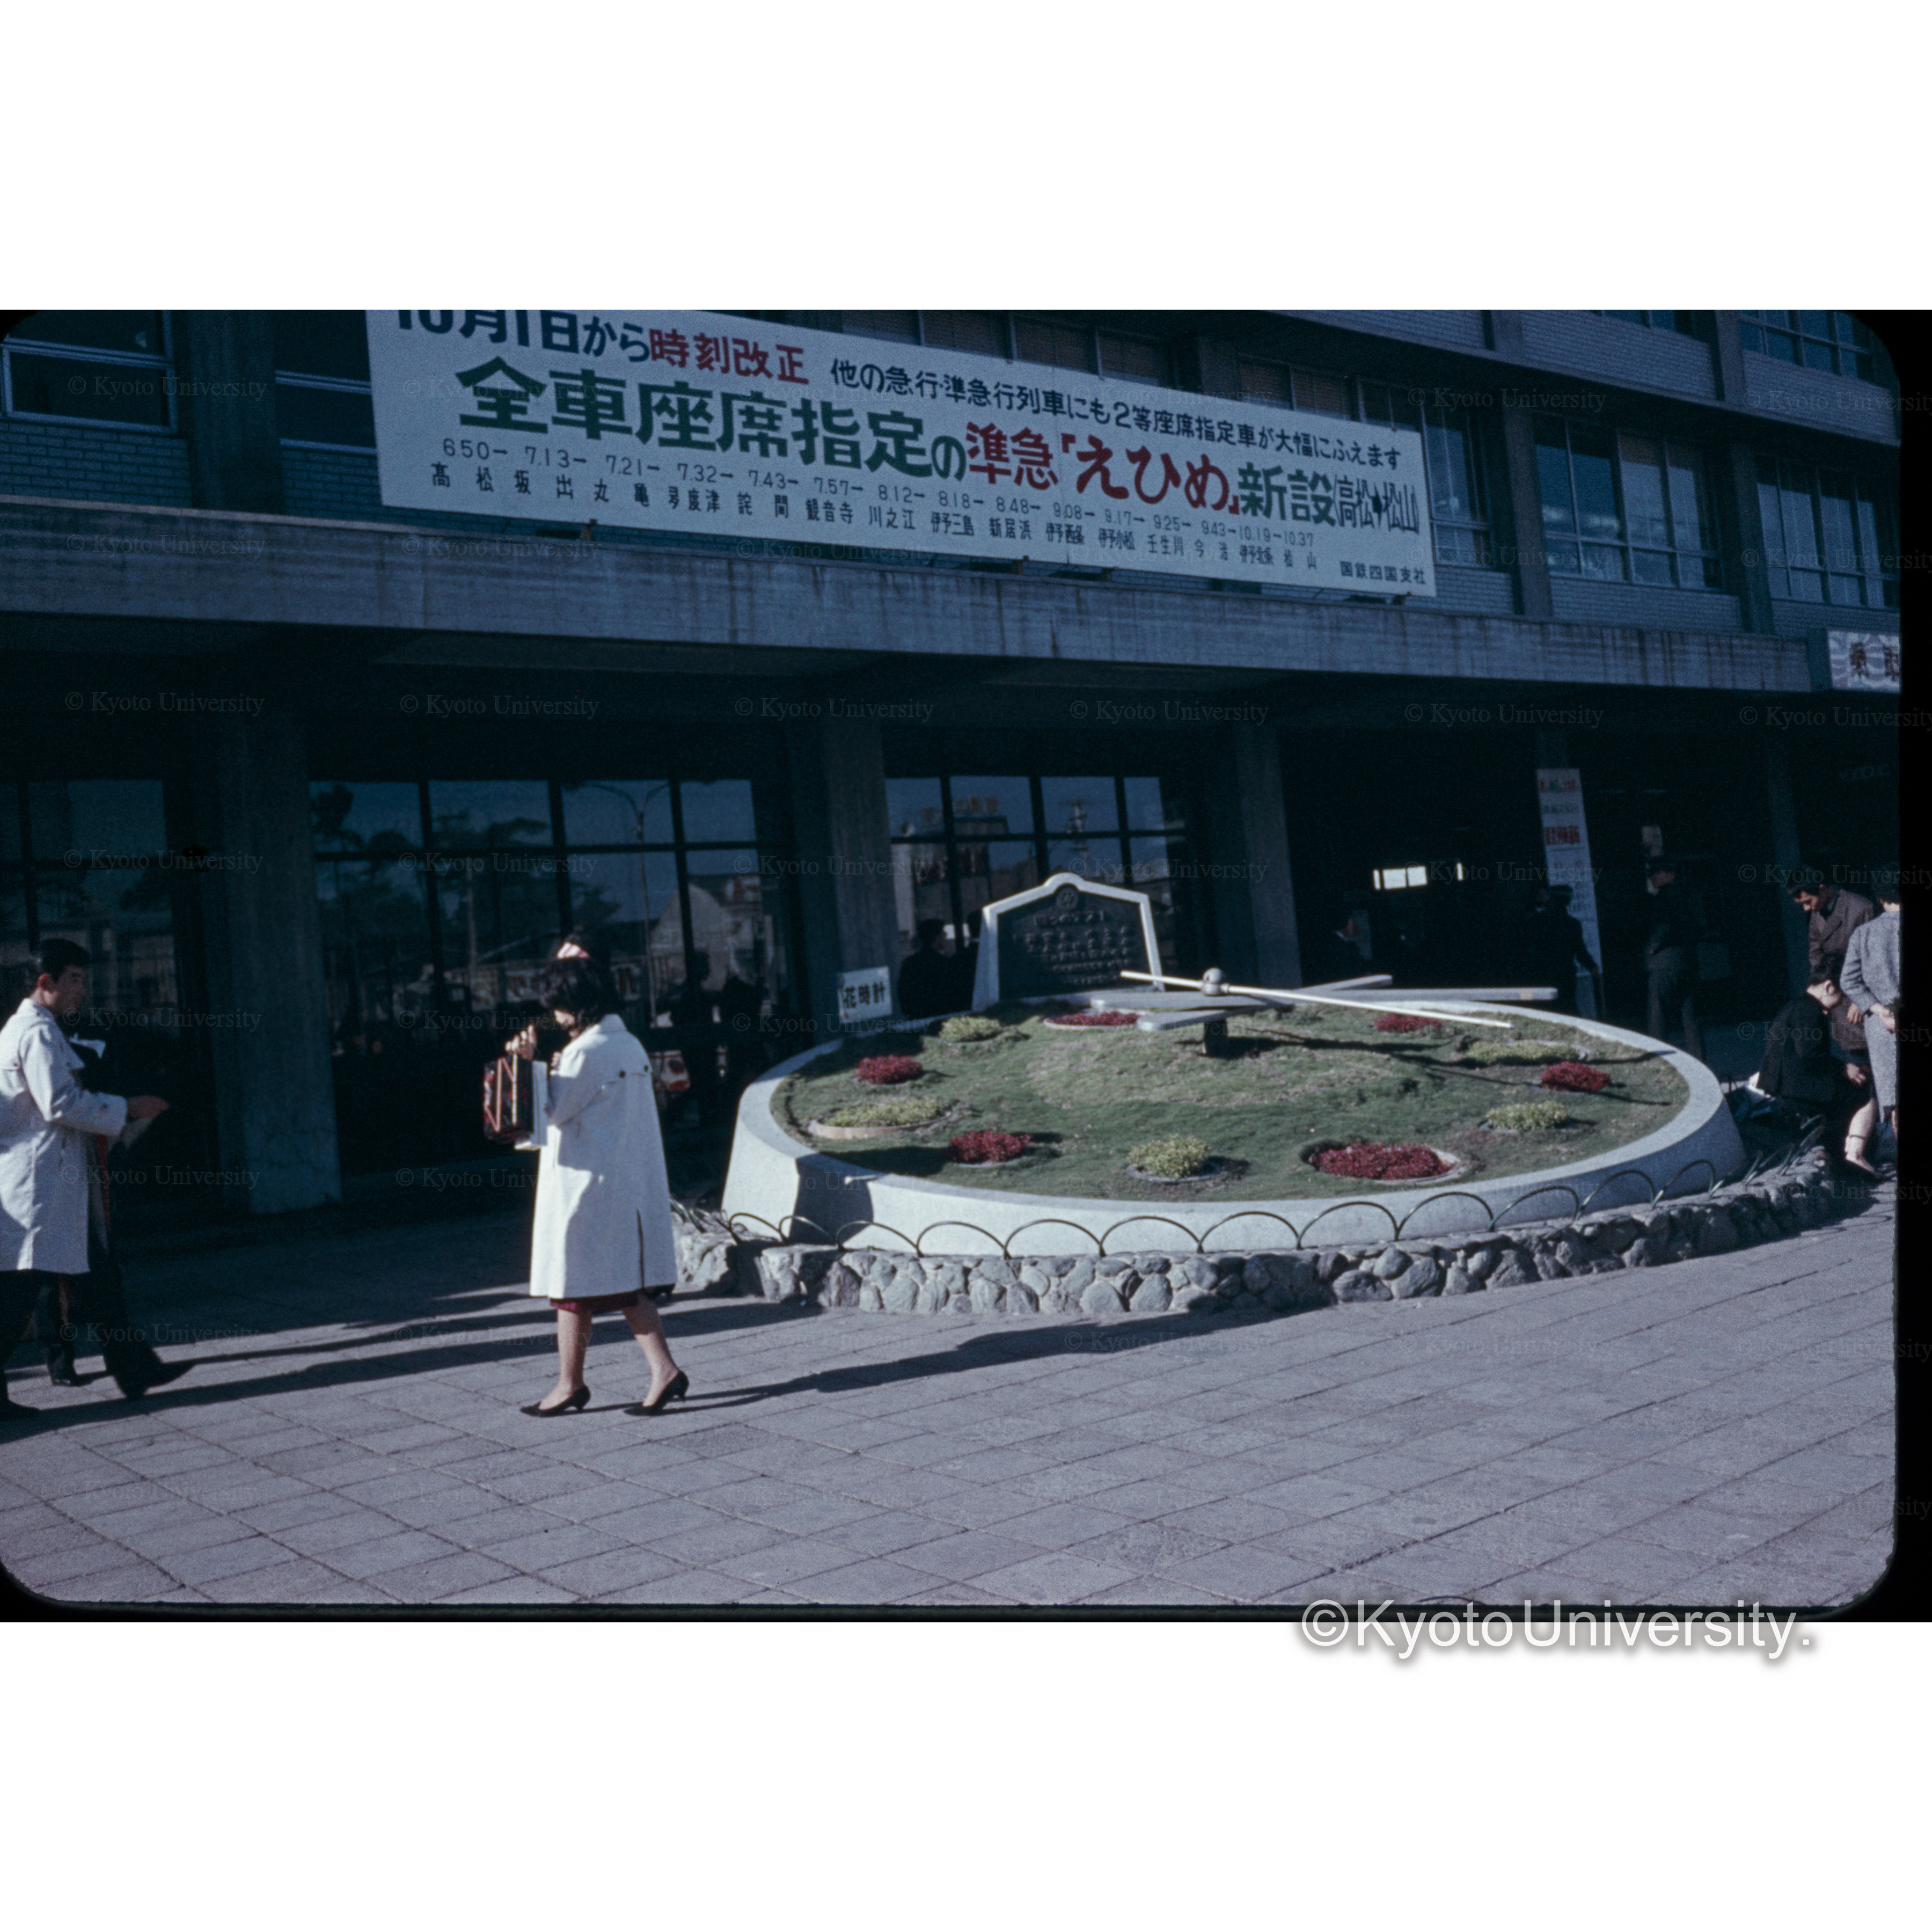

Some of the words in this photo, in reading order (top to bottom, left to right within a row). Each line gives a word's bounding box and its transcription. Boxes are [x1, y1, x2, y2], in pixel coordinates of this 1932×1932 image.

[443, 438, 489, 460] 6.50
[525, 446, 569, 468] 7.13
[606, 455, 641, 475] 7.21
[677, 463, 716, 483] 7.32
[749, 470, 786, 489] 7.43
[814, 477, 848, 495] 7.57
[879, 485, 912, 503] 8.12
[939, 491, 970, 509] 8.18
[1340, 561, 1425, 584] 国鉄四国支社
[842, 979, 885, 1008] 花時計
